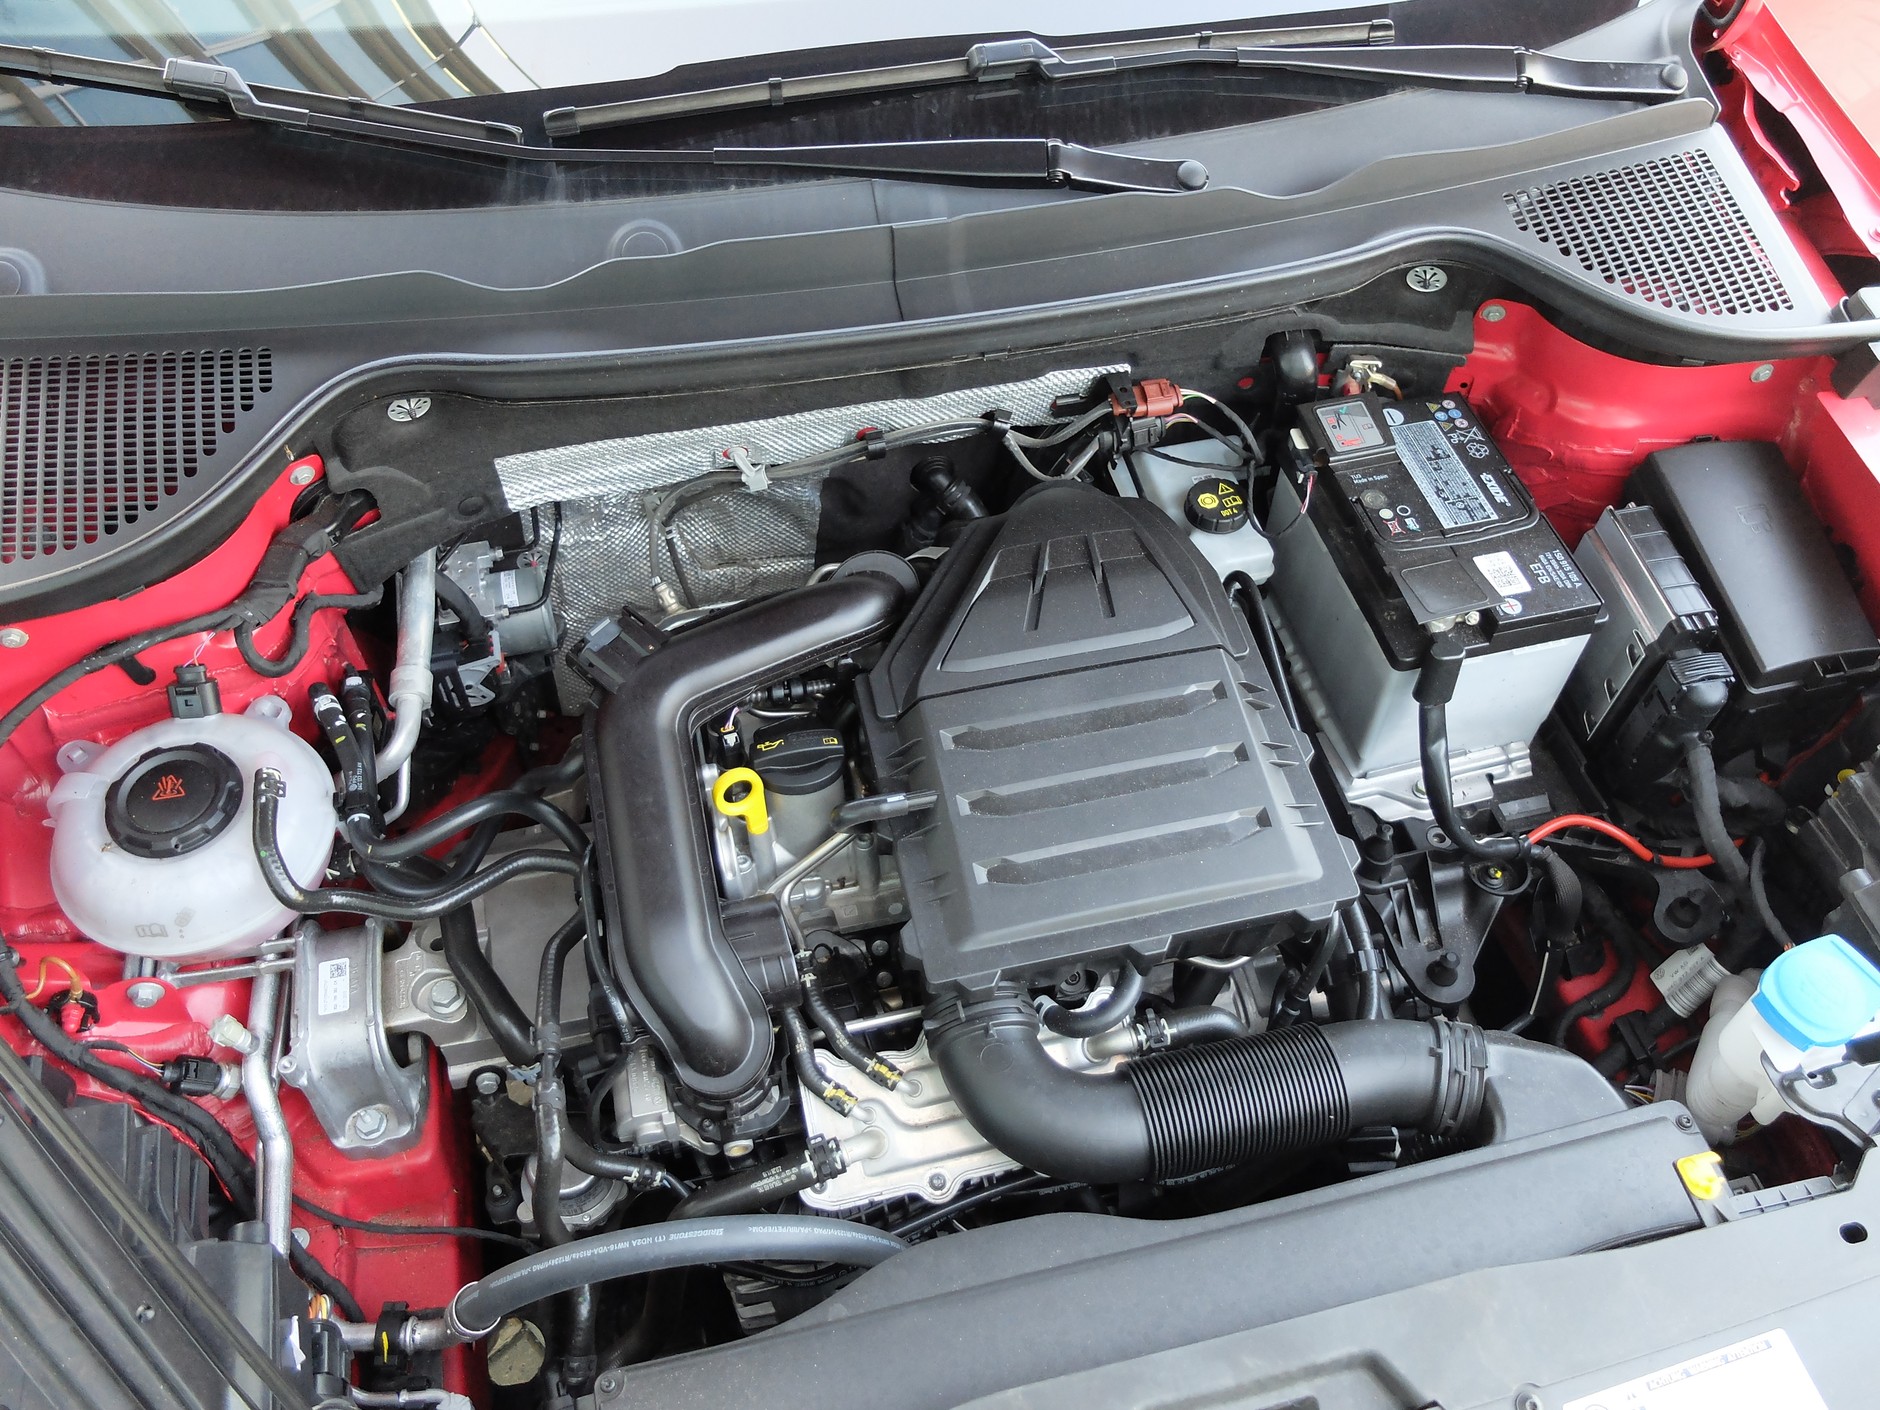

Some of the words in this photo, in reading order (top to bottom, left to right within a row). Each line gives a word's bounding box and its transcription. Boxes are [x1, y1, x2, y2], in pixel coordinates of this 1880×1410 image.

[1447, 433, 1459, 444] Pb
[1480, 472, 1508, 503] EXIDE
[1220, 508, 1233, 517] DOT
[1529, 563, 1551, 585] EFB
[1559, 560, 1572, 572] 915
[1567, 571, 1580, 582] 105
[668, 1228, 724, 1241] BRIDGESTONE
